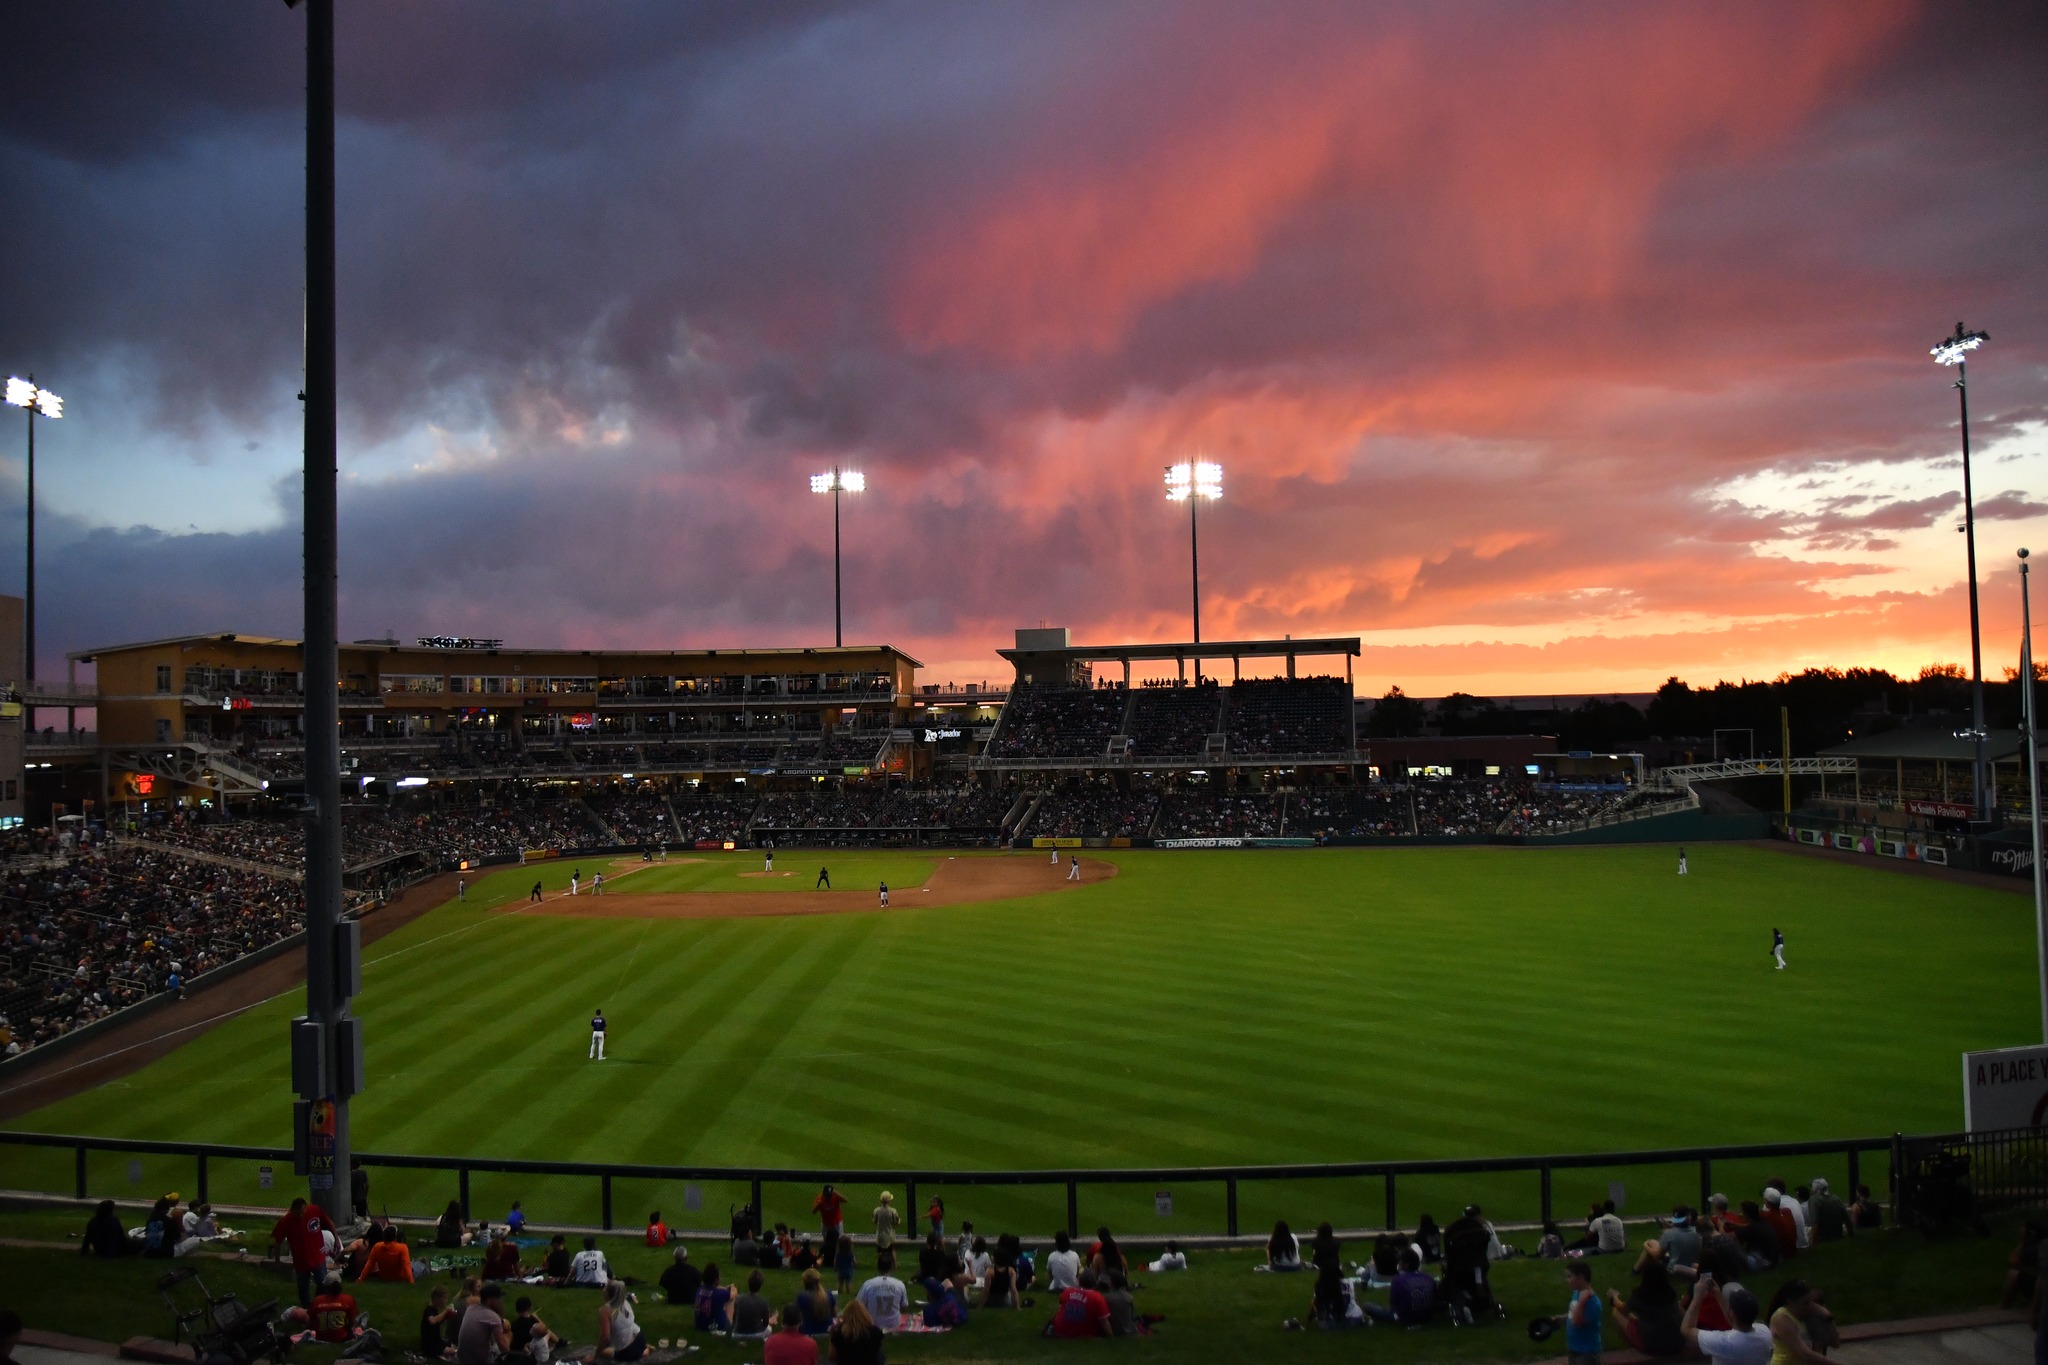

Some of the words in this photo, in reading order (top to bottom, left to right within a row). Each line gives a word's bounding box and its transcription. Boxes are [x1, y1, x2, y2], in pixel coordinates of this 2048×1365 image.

[1937, 804, 1967, 818] Pavilion
[1166, 839, 1216, 849] DIAMOND
[1217, 839, 1243, 848] PRO
[1977, 1064, 1987, 1086] A
[1990, 1058, 2037, 1085] PLACE
[583, 1259, 598, 1272] 23
